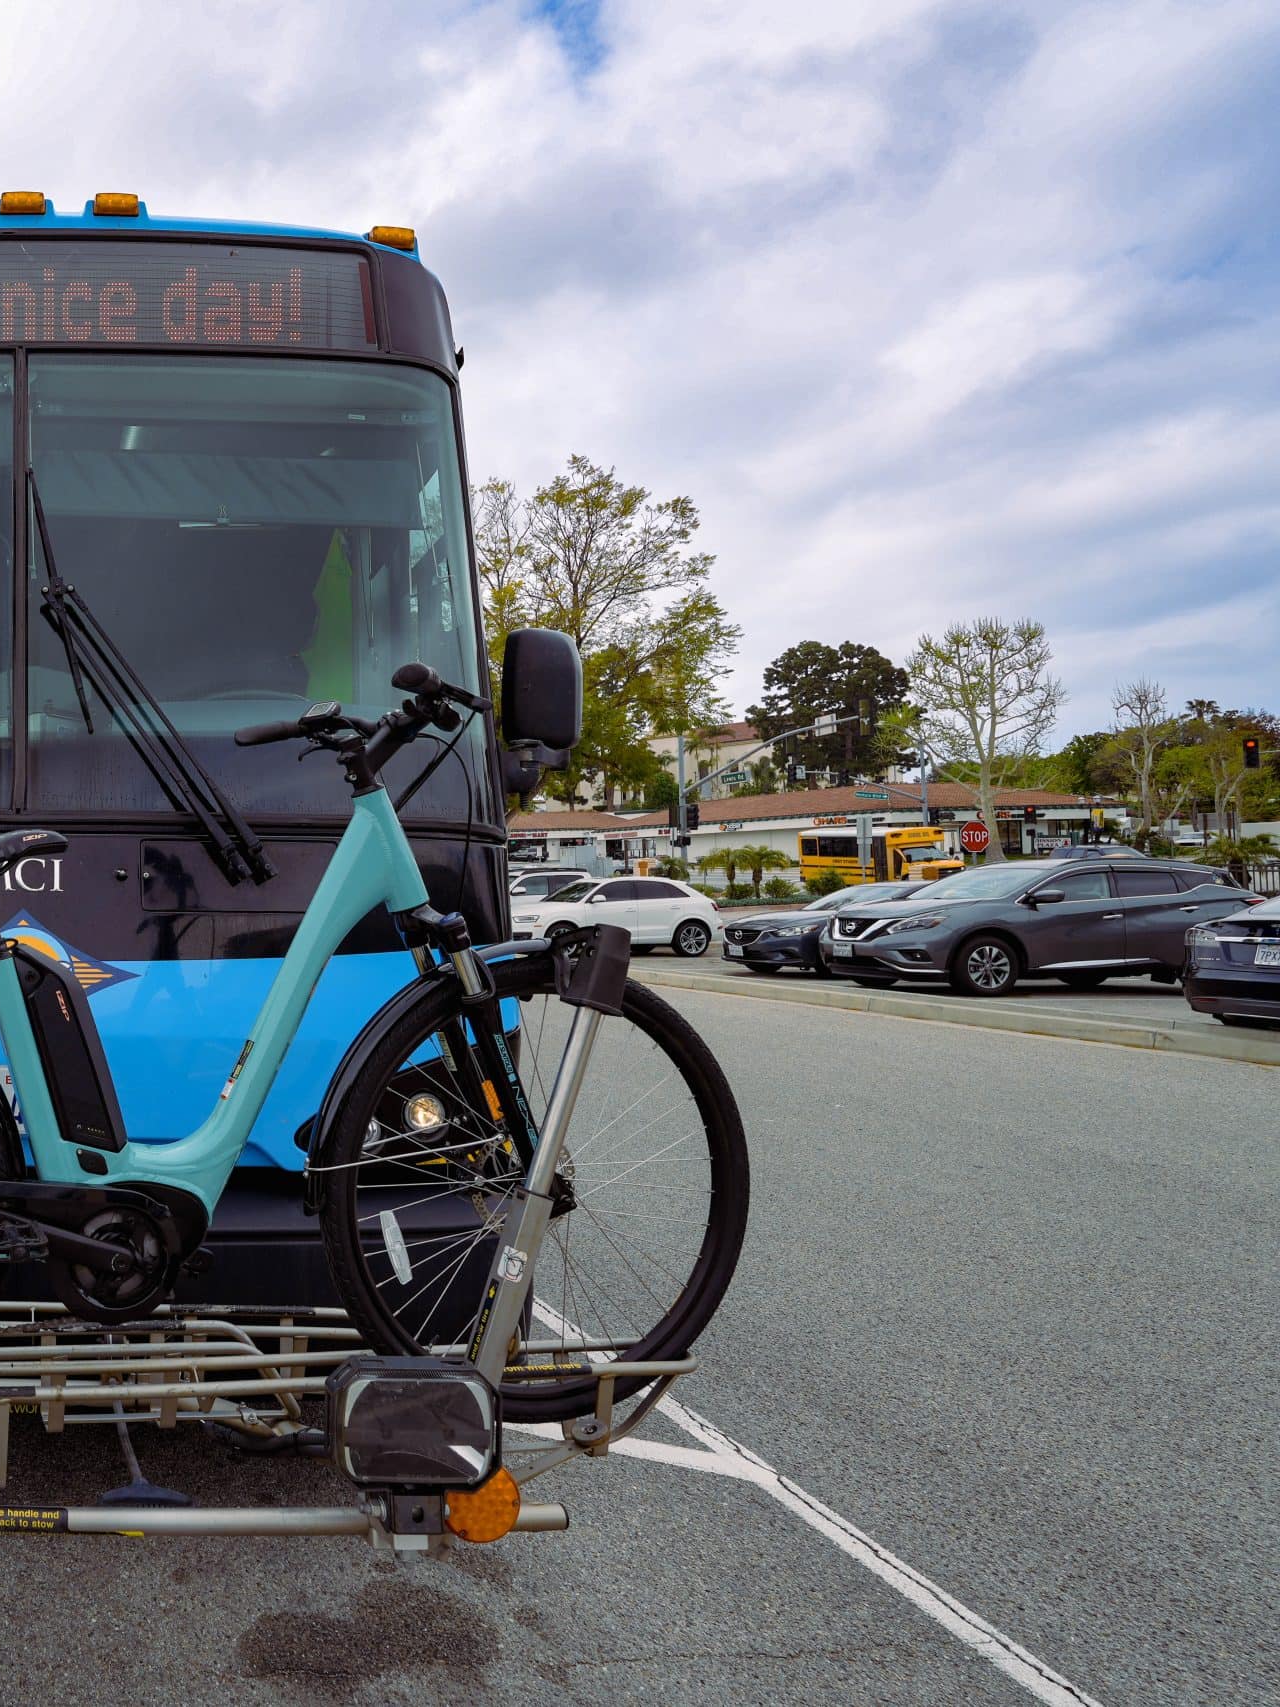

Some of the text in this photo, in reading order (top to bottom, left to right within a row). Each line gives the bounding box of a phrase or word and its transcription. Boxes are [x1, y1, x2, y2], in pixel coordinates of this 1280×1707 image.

[1, 265, 137, 342] nice
[162, 265, 302, 342] day!
[962, 831, 988, 843] STOP
[7, 1507, 39, 1518] handle
[41, 1510, 60, 1519] and
[18, 1519, 29, 1528] to
[31, 1519, 55, 1529] stow
